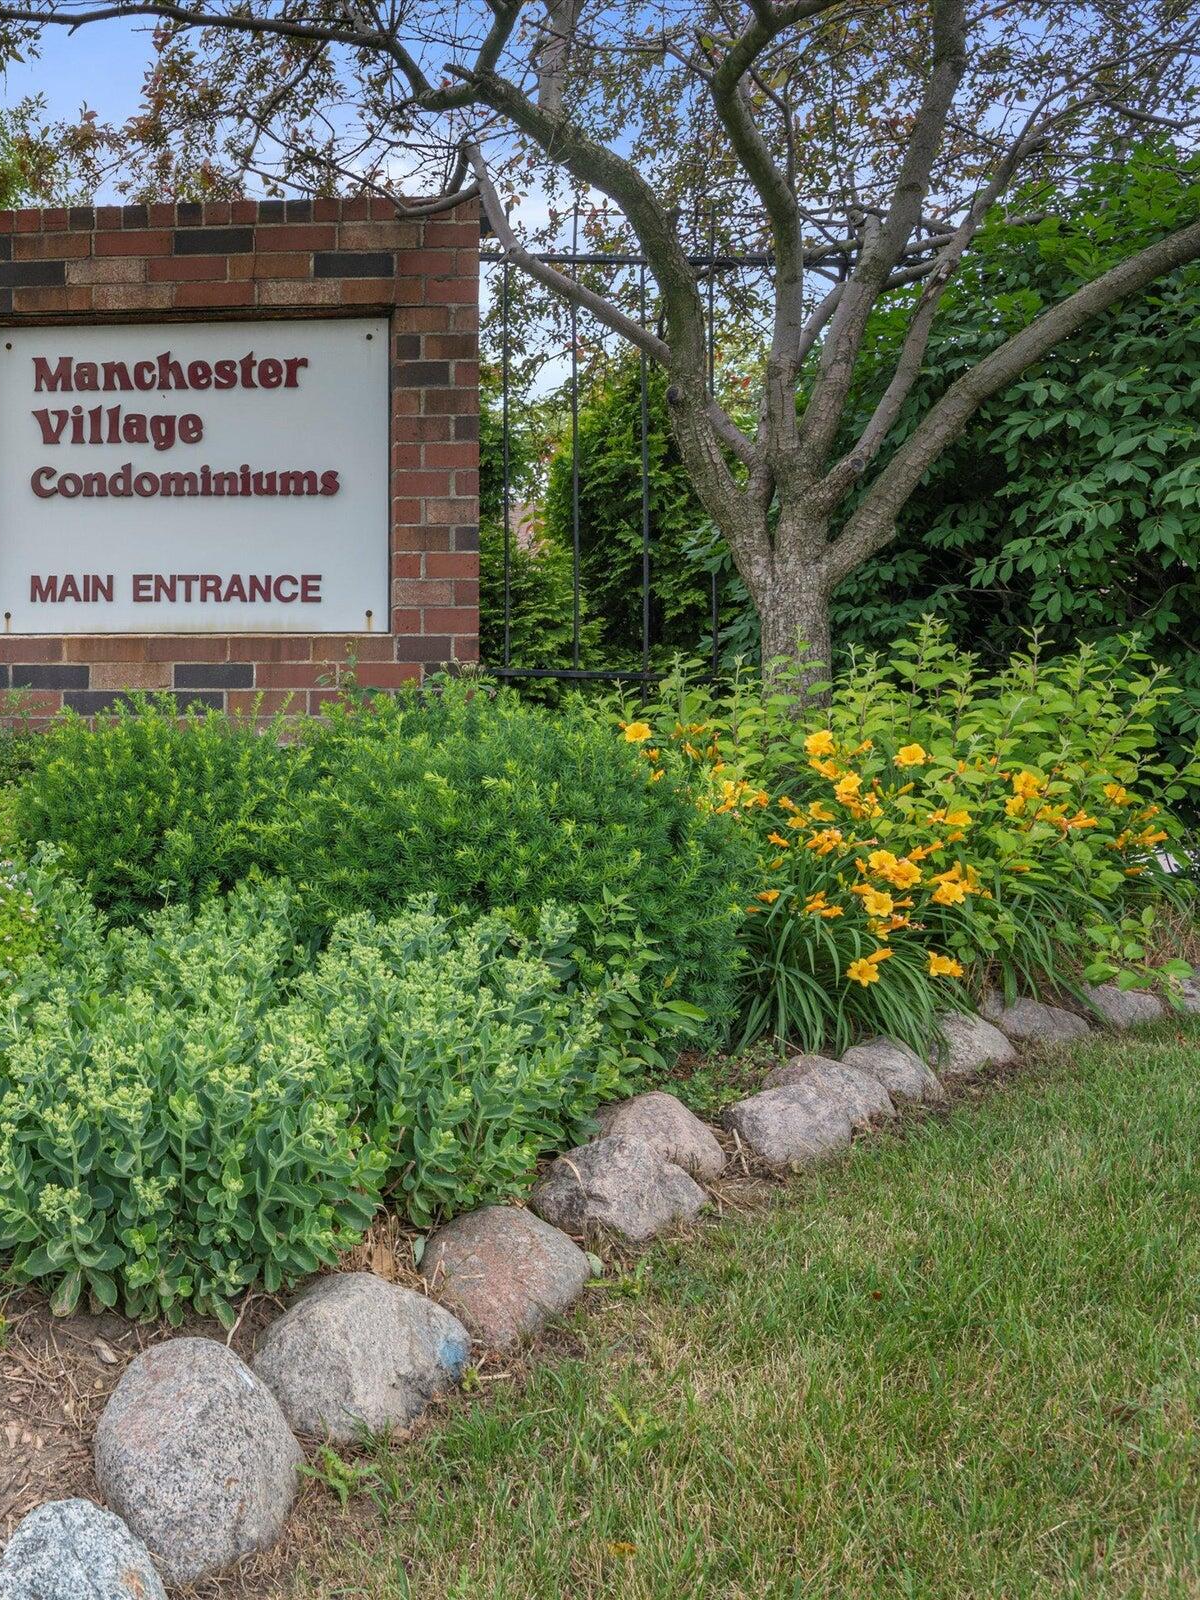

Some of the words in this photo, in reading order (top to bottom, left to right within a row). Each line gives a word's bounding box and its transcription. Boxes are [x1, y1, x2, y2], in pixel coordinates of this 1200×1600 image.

[32, 351, 309, 392] Manchester
[32, 405, 204, 451] Village
[30, 463, 340, 498] Condominiums
[30, 574, 114, 603] MAIN
[132, 573, 322, 603] ENTRANCE
